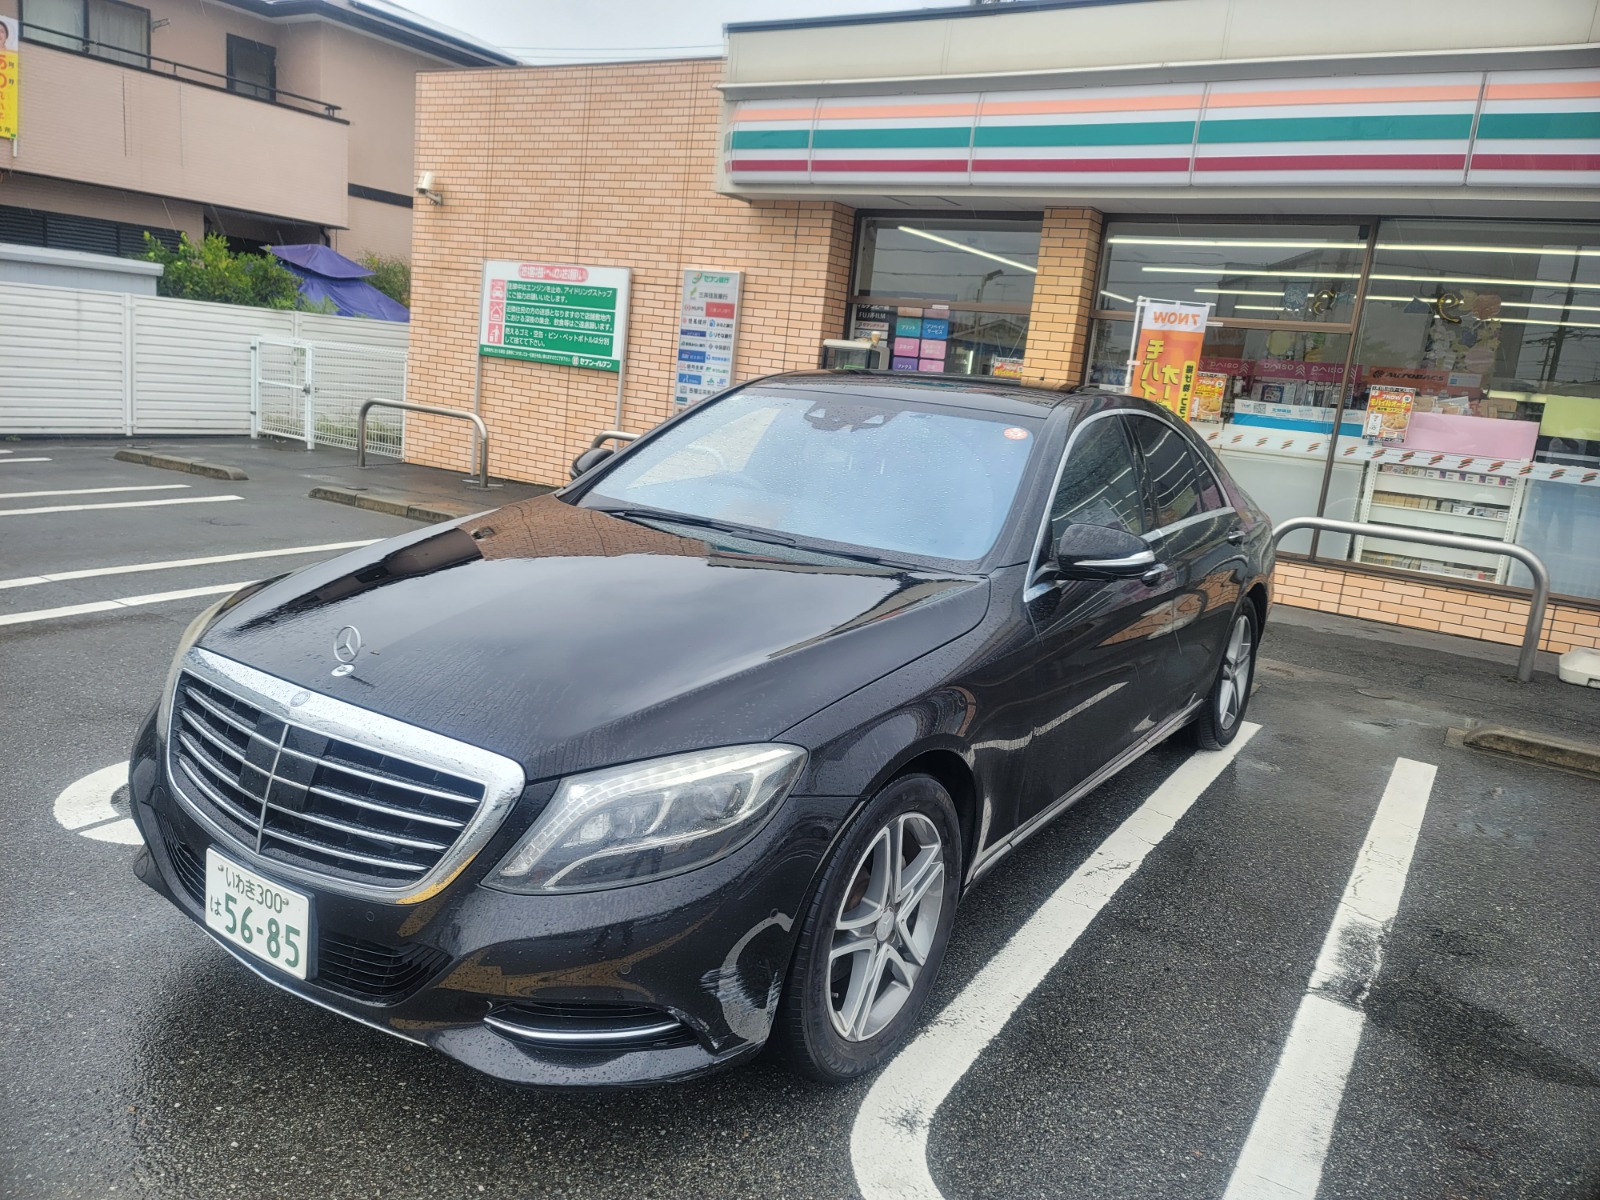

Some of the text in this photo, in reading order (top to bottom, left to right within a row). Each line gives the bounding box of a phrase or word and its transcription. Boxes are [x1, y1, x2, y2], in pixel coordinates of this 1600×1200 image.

[704, 275, 730, 284] セブン銀行
[858, 311, 886, 319] FUJIFILM
[1210, 361, 1239, 369] DAISO
[1264, 363, 1294, 371] DAISO
[1312, 365, 1344, 374] DAISO
[1386, 371, 1444, 382] AUTOBACS
[210, 895, 222, 917] は
[224, 892, 301, 968] 56-85
